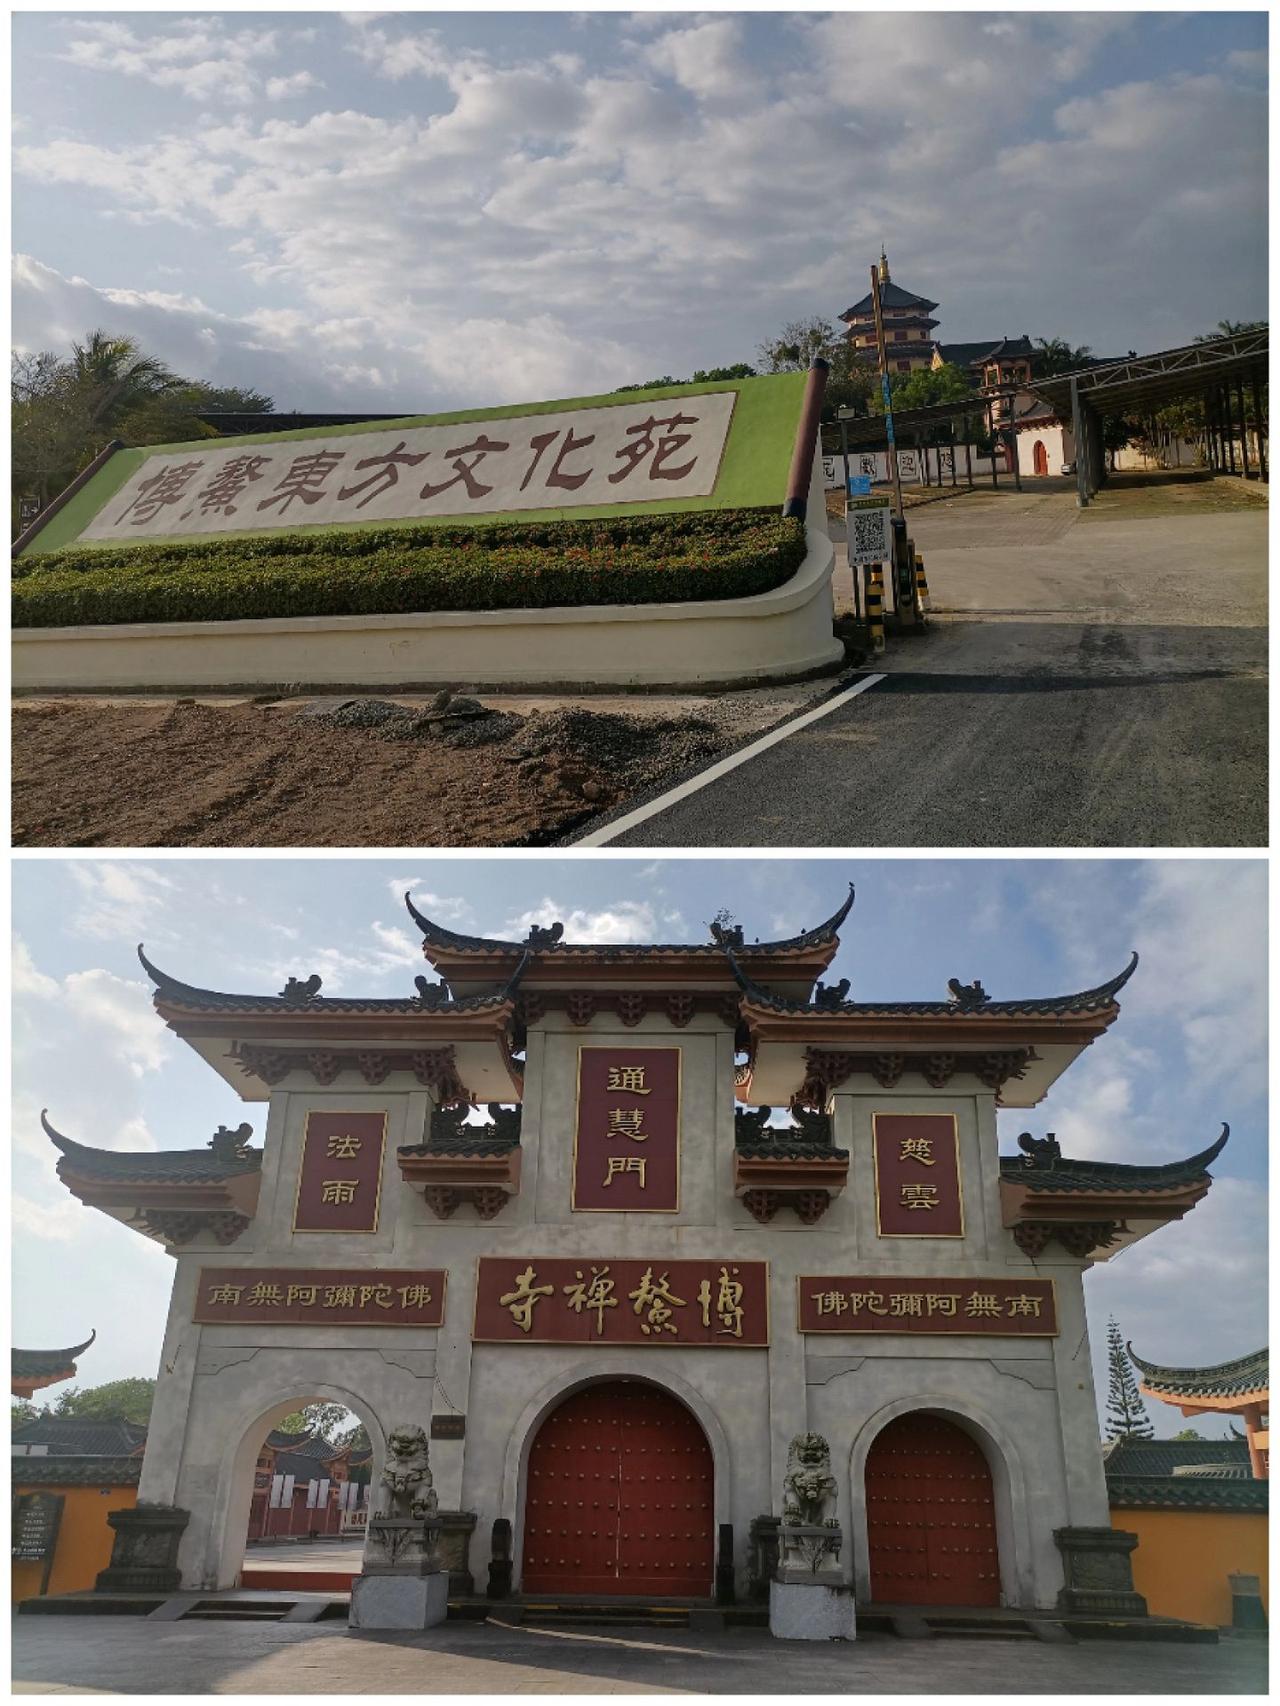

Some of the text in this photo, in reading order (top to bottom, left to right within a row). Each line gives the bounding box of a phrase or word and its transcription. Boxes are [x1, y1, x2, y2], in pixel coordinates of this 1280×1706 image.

[603, 1066, 652, 1189] 通慧門
[322, 1135, 362, 1206] 法雨
[899, 1137, 940, 1210] 慈雲
[208, 1280, 433, 1310] 南無阿彌陀佛
